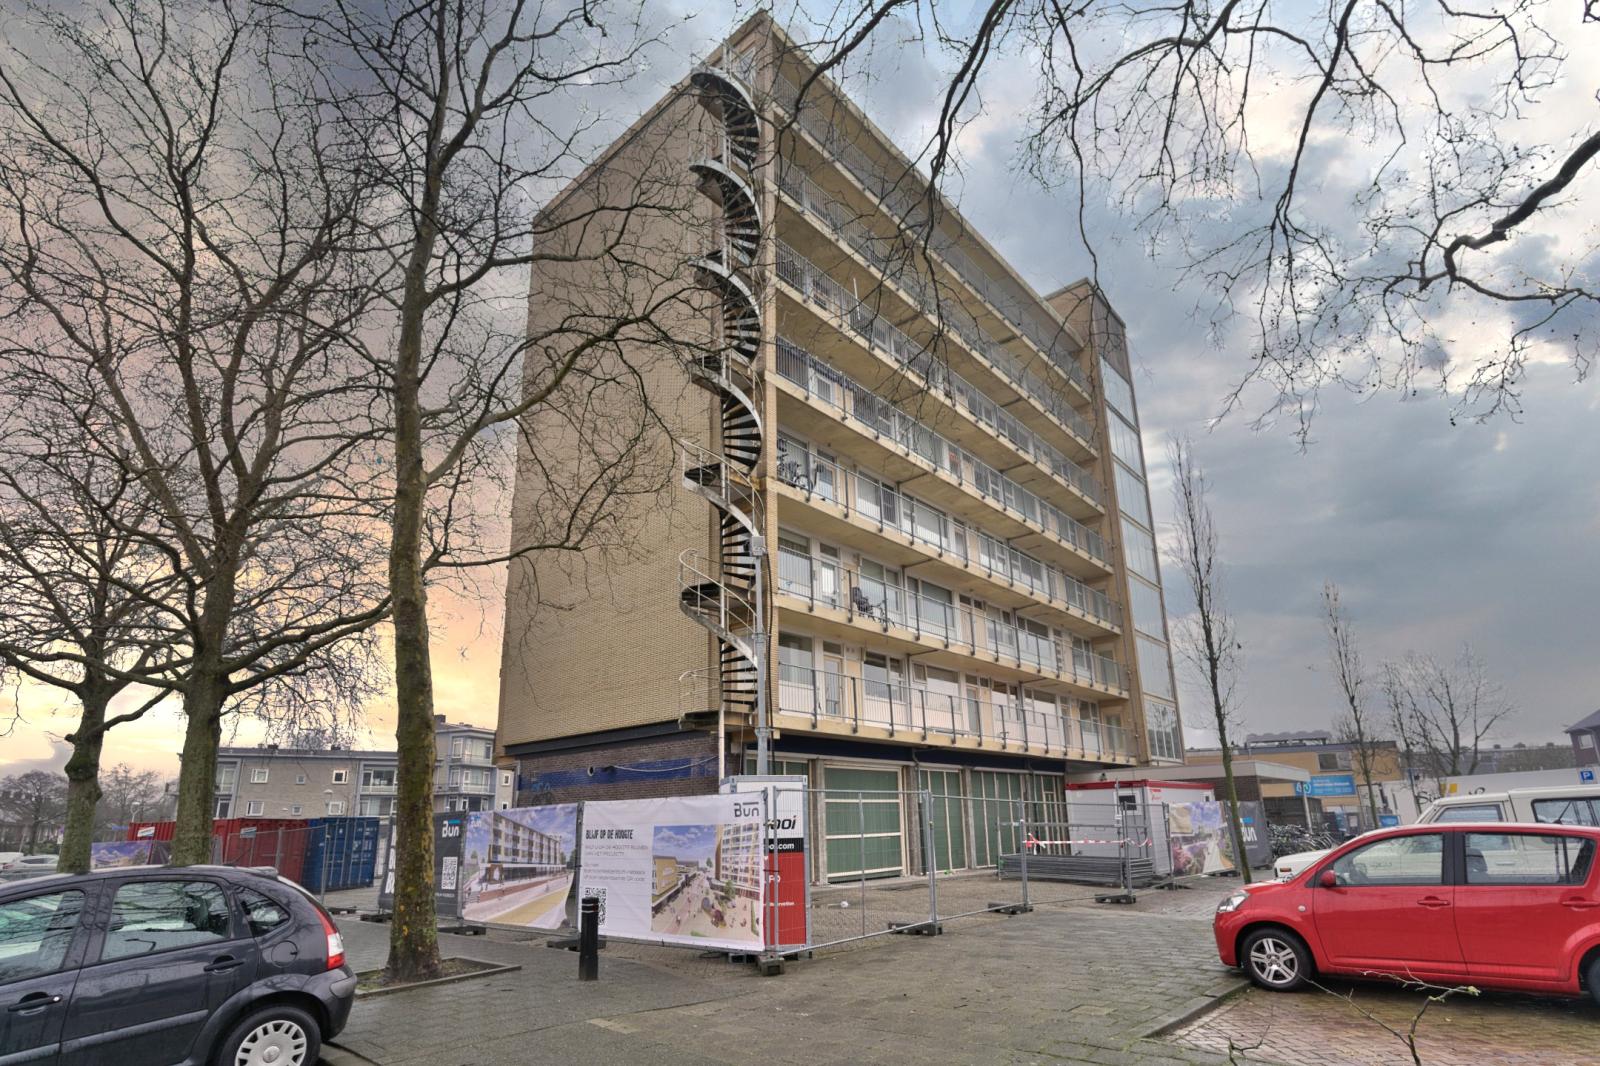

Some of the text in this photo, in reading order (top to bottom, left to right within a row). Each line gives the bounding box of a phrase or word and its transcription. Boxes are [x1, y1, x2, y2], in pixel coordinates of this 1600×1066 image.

[585, 829, 634, 840] BLIJF OP DE HOOGTE
